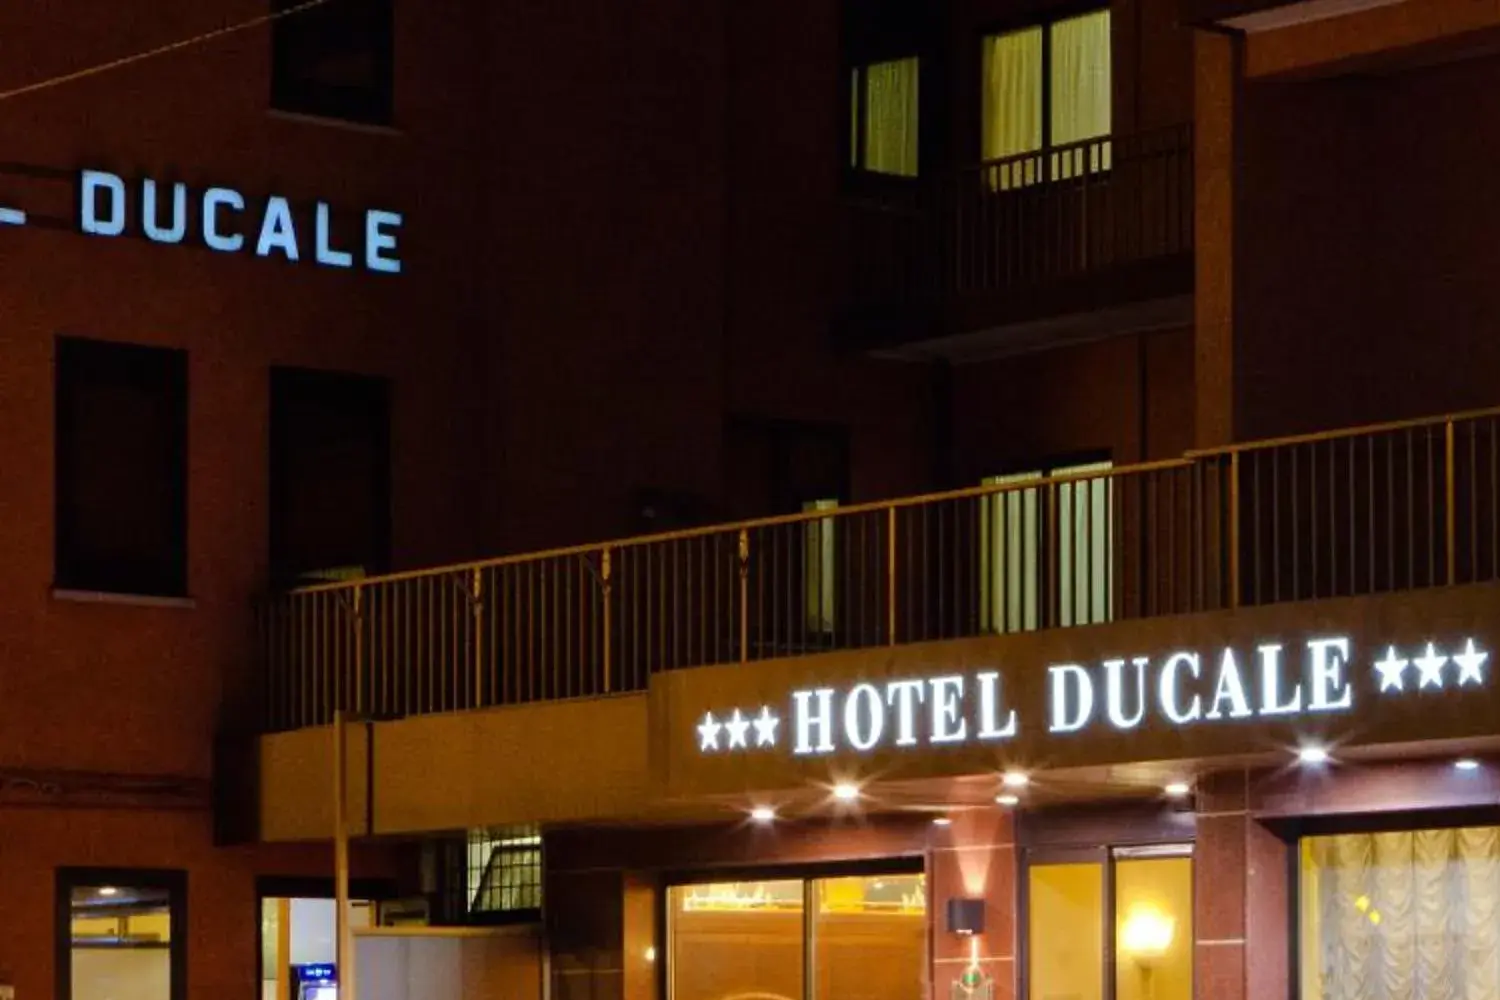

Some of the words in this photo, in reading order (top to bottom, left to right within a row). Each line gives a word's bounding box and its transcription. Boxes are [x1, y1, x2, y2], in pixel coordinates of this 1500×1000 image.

[81, 170, 404, 273] DUCALE
[790, 670, 1018, 756] HOTEL
[1046, 635, 1354, 734] DUCALE
